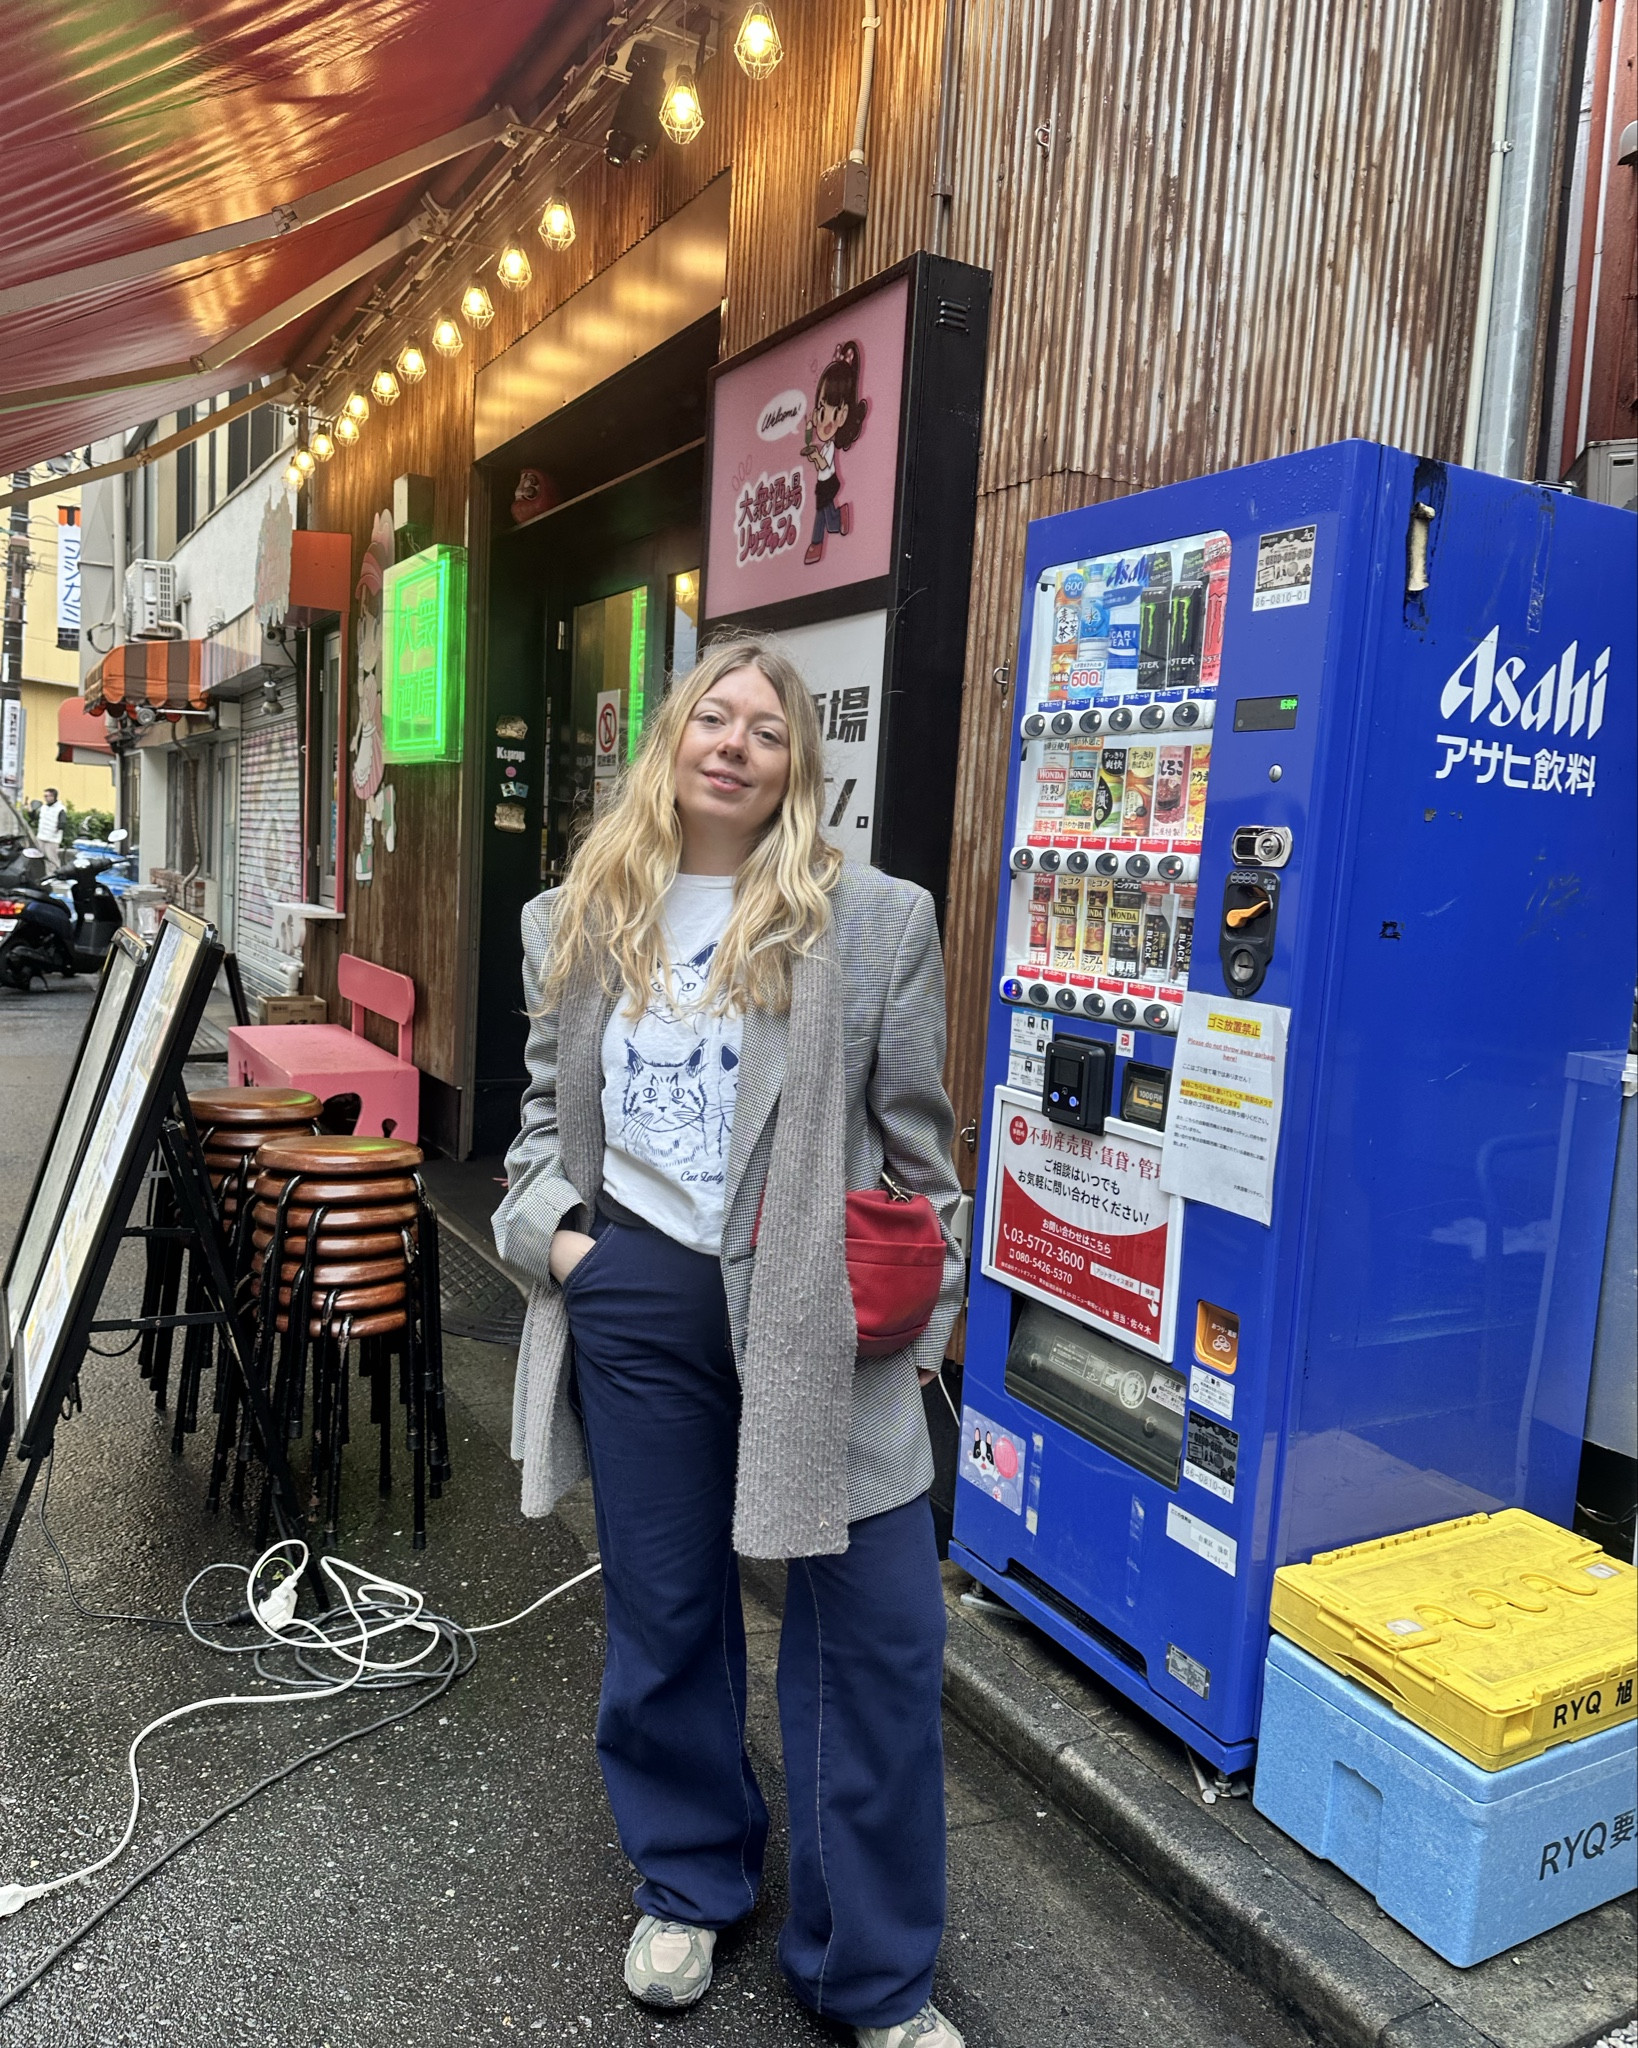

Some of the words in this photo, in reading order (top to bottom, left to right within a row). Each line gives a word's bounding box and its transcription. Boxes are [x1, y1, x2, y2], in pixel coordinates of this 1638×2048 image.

[761, 402, 802, 432] Welcome!
[738, 471, 803, 527] 大衆酒場
[1064, 581, 1084, 592] 600
[1255, 590, 1308, 608] 86-0810-01
[400, 597, 436, 655] 大衆
[399, 666, 436, 722] 酒場
[1071, 671, 1099, 687] 600
[1440, 624, 1611, 740] Asahi
[1104, 751, 1124, 759] すっきり
[1106, 760, 1123, 770] 爽快
[1132, 751, 1154, 760] すっきり
[1435, 734, 1597, 797] アサヒ飲料
[1039, 769, 1064, 780] WONDA
[1041, 783, 1060, 795] 特製
[1110, 909, 1137, 921] WONDA
[1144, 929, 1154, 959] BLACK
[1177, 932, 1187, 963] BLACK
[1207, 1017, 1261, 1038] ゴミ放置禁止
[1187, 1037, 1204, 1045] Please
[1205, 1041, 1212, 1049] do
[1223, 1044, 1239, 1053] throw
[1240, 1048, 1255, 1056] away
[1223, 1054, 1238, 1063] here!
[680, 1170, 698, 1182] Cat
[700, 1171, 724, 1185] Lady
[1044, 1158, 1121, 1196] ご相談はいつでも
[1010, 1227, 1085, 1271] 03-5772-3600
[1042, 1218, 1111, 1254] お問い合わせはこちら
[1015, 1249, 1073, 1285] 080-5426-5370
[1112, 1310, 1152, 1336] 担当：佐々木
[1185, 1464, 1232, 1499] 86-0810-01
[1552, 1690, 1602, 1730] RYQ
[1615, 1679, 1633, 1707] 旭
[1539, 1807, 1638, 1881] RYQ要
